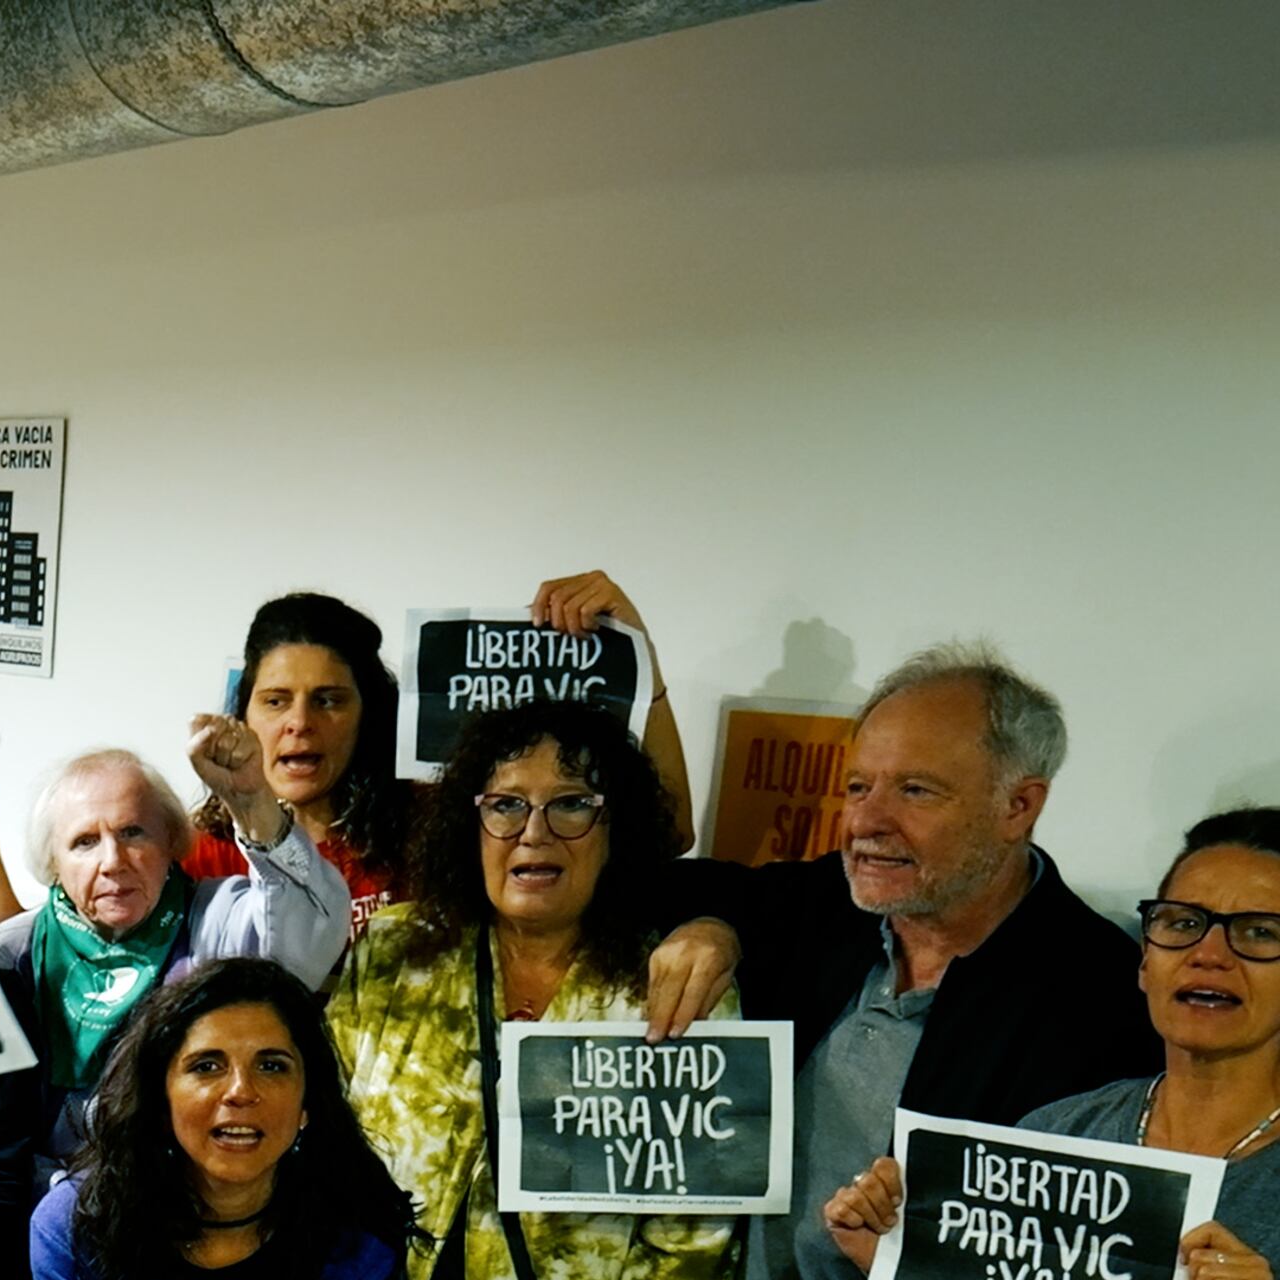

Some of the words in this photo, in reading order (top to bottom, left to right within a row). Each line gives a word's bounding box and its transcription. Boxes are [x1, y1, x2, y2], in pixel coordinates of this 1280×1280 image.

[0, 449, 52, 469] CRIMEN
[15, 425, 53, 445] VACIA
[465, 622, 602, 670] LIBERTAD
[448, 674, 533, 711] PARA
[570, 1040, 727, 1090] LIBERTAD
[553, 1095, 653, 1143] PARA
[660, 1094, 736, 1140] VIC
[603, 1138, 688, 1195] ¡YA!
[962, 1143, 1131, 1225] LIBERTAD
[938, 1200, 1044, 1271] PARA
